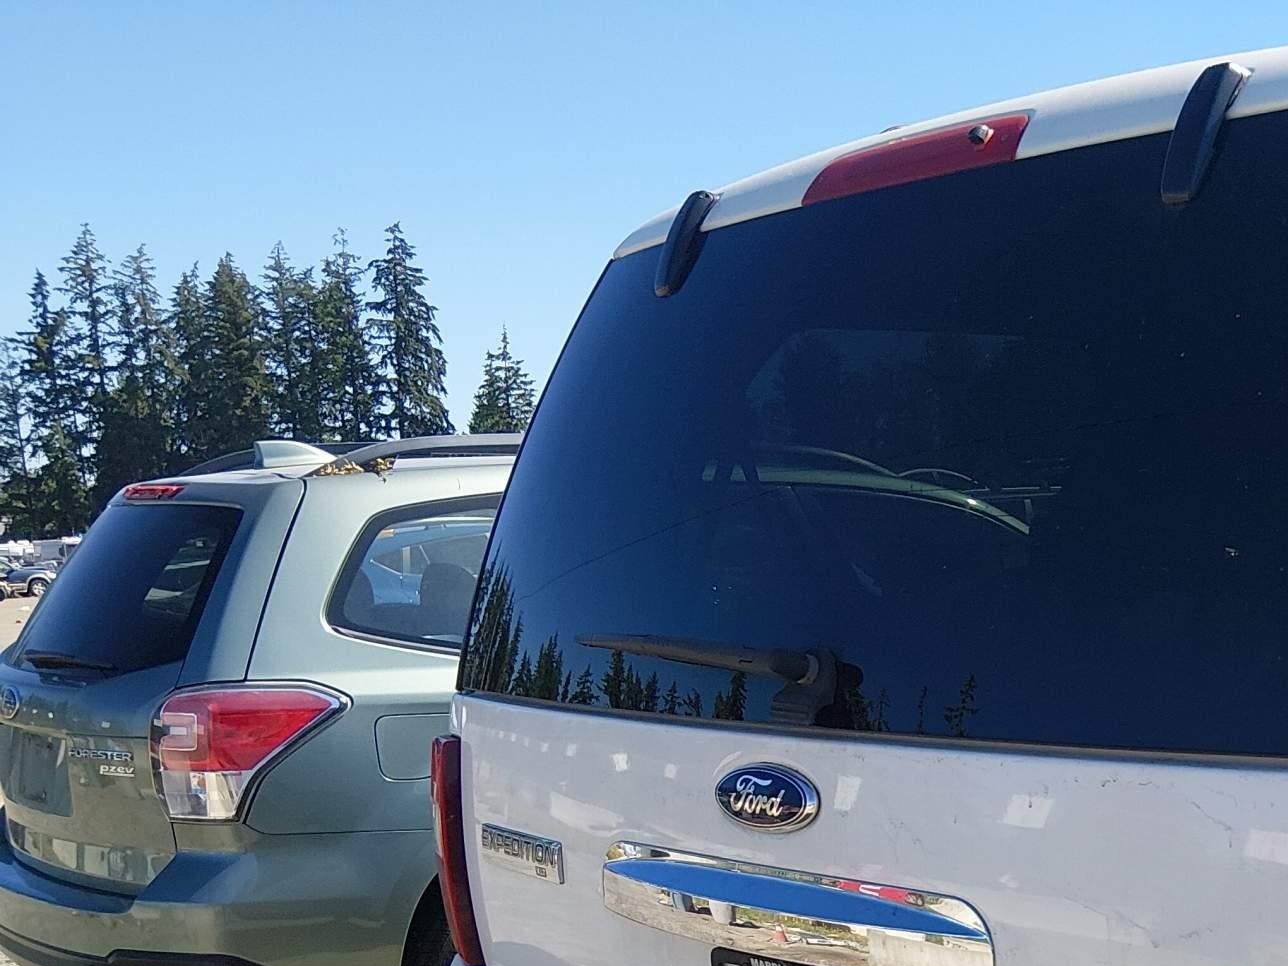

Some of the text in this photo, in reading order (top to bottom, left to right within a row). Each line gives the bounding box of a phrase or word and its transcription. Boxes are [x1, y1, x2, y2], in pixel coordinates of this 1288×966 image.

[69, 749, 133, 761] FORESTER
[728, 775, 786, 817] Ford
[481, 829, 556, 868] EXPEDITION
